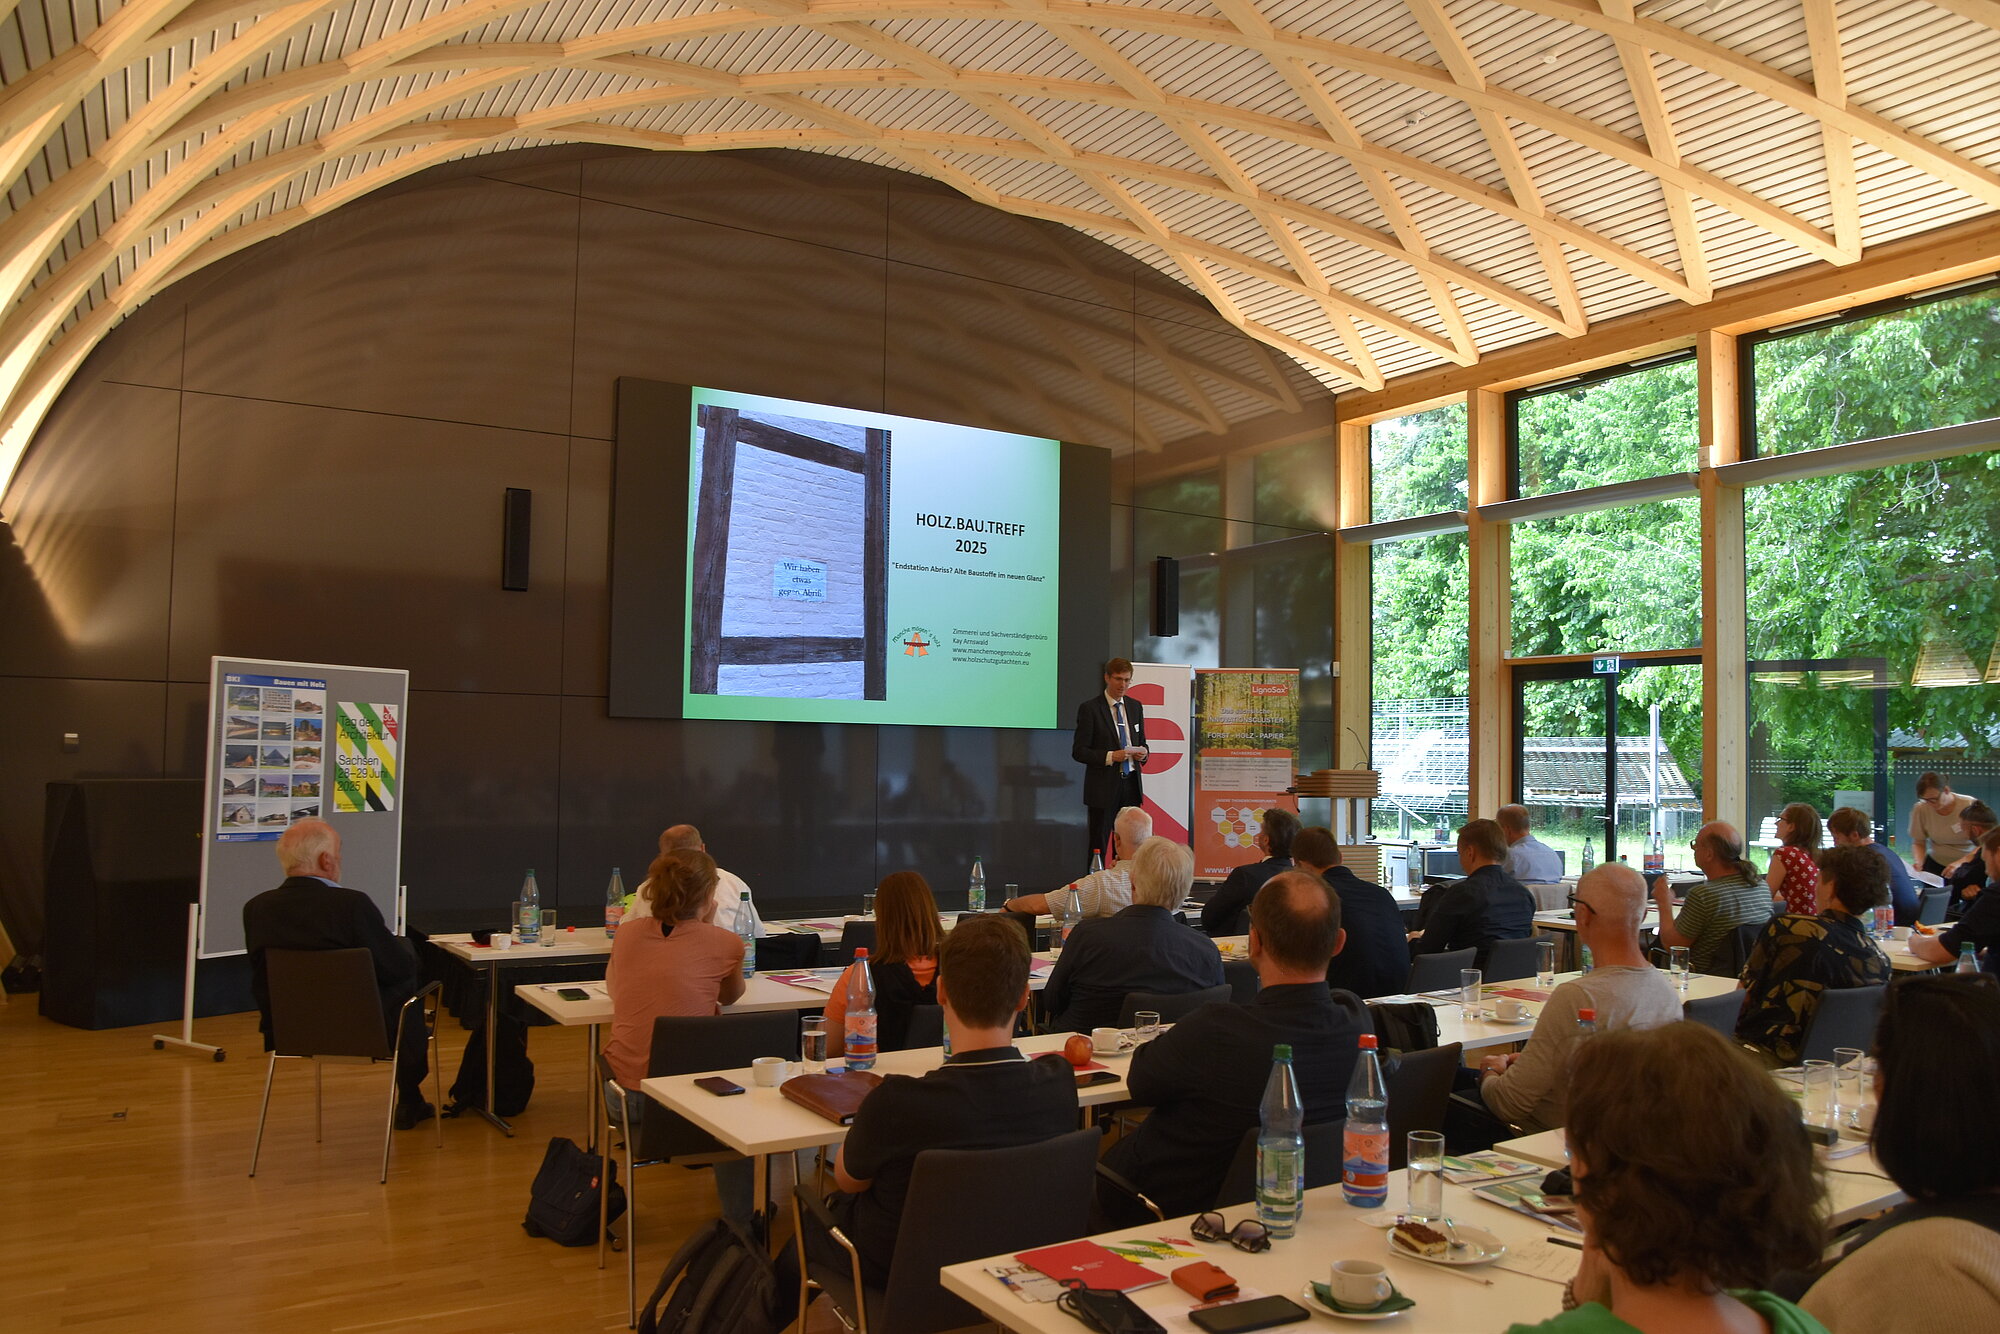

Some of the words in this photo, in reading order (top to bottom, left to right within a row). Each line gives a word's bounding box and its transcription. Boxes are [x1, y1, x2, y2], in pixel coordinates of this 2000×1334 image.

[916, 512, 1025, 536] HOLZ.BAU.TREFF
[955, 539, 988, 555] 2025
[783, 562, 798, 571] Wir
[799, 564, 820, 573] haben
[892, 562, 929, 572] "Endstation
[930, 565, 953, 574] Abriss?
[954, 567, 967, 576] Alte
[968, 569, 997, 578] Baustoffe
[1026, 574, 1046, 582] Glanz"
[792, 576, 812, 584] etwas
[952, 628, 978, 636] Zimmerei
[991, 630, 1048, 641] Sachverständigenbüro
[952, 638, 963, 646] Kay
[952, 647, 1032, 657] www.manchemoegensholz.de
[952, 656, 1030, 666] www.holzschutzgutachten.eu
[1252, 685, 1287, 694] LignoSax
[339, 715, 357, 727] Tag
[358, 716, 374, 728] der
[1207, 716, 1285, 724] INNOVATIONSCLUSTER
[339, 728, 390, 741] Architektur
[338, 754, 380, 766] Sachsen
[368, 767, 388, 779] Juni
[337, 780, 361, 792] 2025
